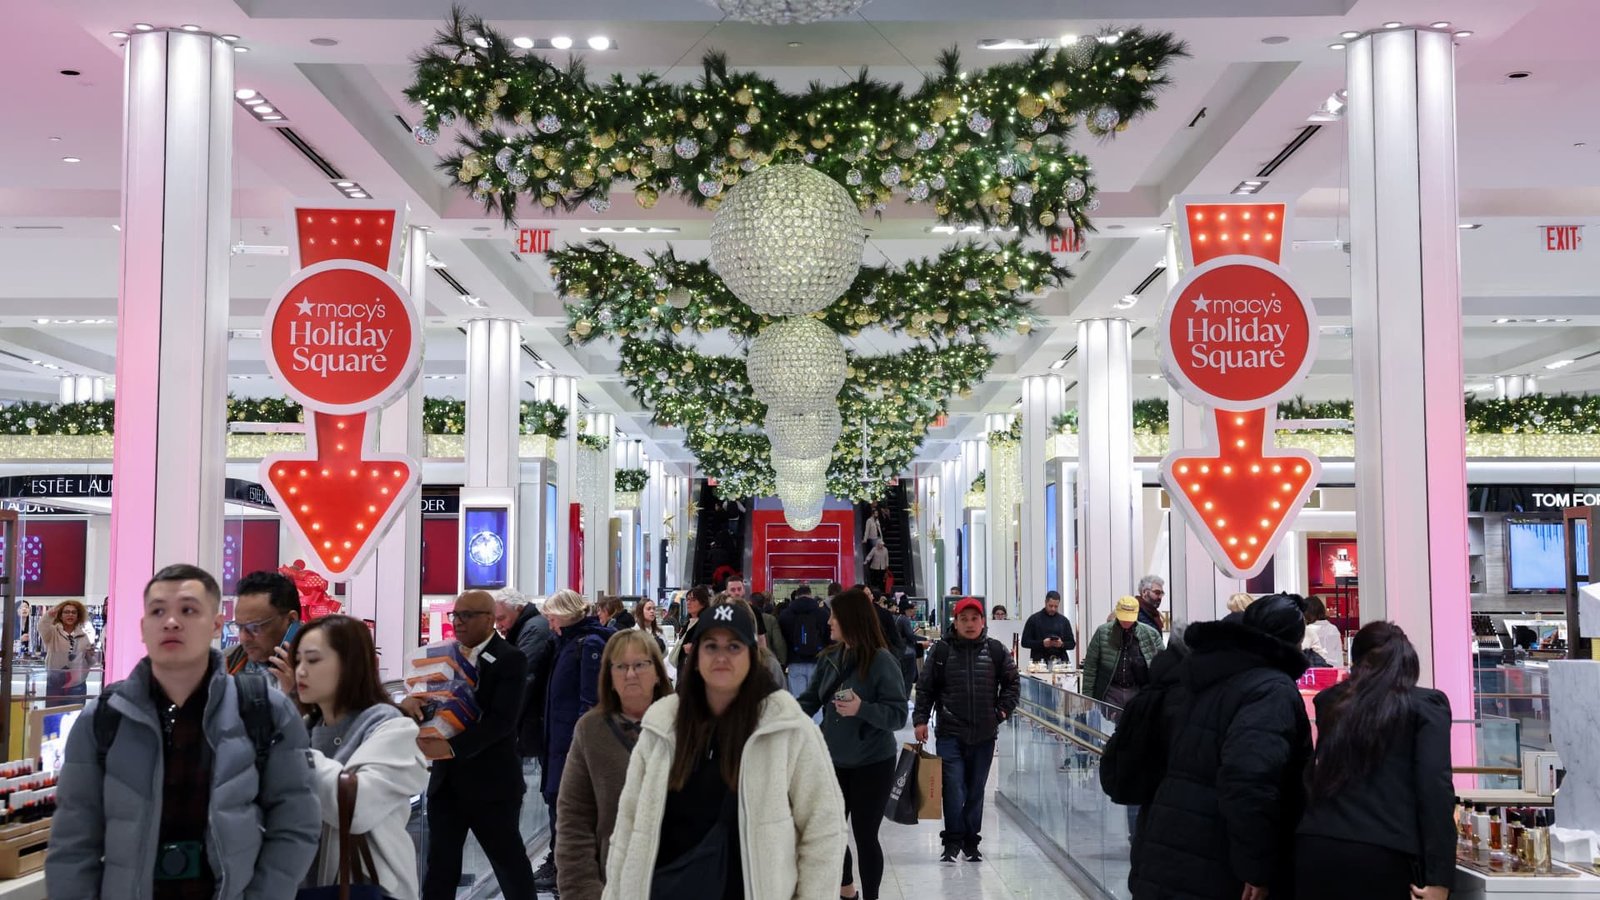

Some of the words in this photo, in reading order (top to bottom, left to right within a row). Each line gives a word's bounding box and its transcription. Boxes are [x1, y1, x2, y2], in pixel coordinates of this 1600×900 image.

[520, 229, 550, 254] EXIT
[1547, 226, 1578, 250] EXIT
[317, 297, 386, 322] macy's
[1213, 292, 1282, 318] macy's
[289, 320, 394, 353] Holiday
[1187, 316, 1290, 348] Holiday
[293, 346, 387, 378] Square
[1191, 343, 1285, 374] Square
[79, 479, 113, 493] LAU
[1531, 493, 1570, 508] TOM
[713, 604, 734, 621] NY
